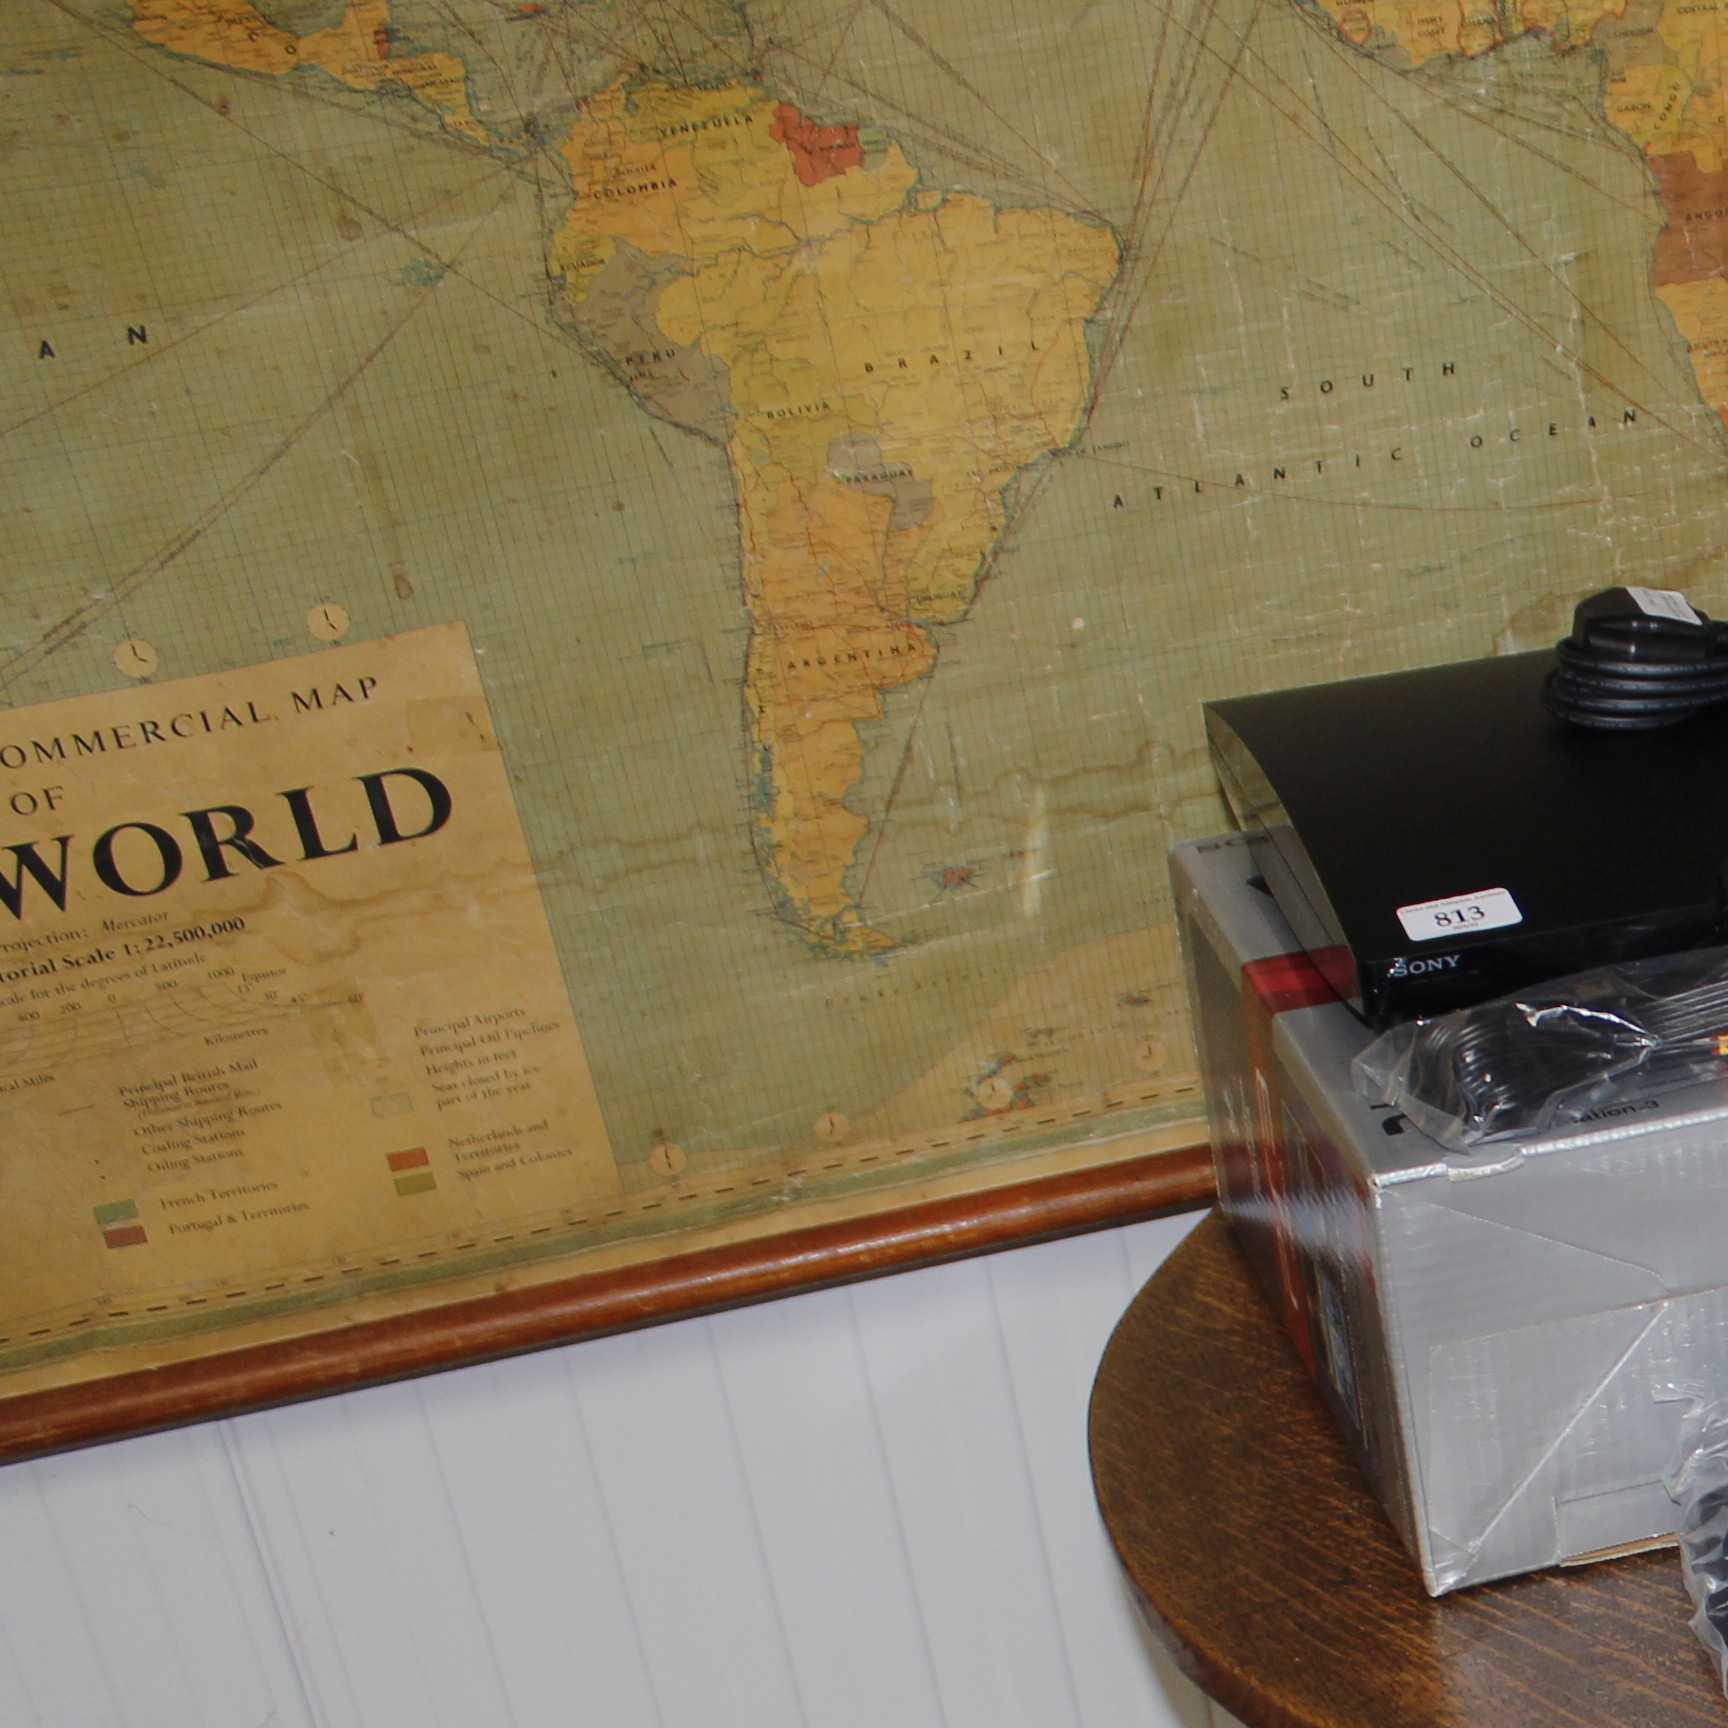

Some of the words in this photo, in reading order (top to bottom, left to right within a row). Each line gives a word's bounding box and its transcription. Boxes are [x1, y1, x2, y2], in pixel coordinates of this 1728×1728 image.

[659, 115, 754, 138] VENEZUELA
[592, 178, 678, 200] COLOMBIA
[625, 350, 677, 365] PERU
[864, 340, 1039, 373] BRAZIL
[1280, 362, 1456, 400] SOUTH
[766, 401, 831, 419] BOLIVIA
[1112, 447, 1403, 510] ATLANTIC
[1469, 408, 1638, 449] OCEAN
[787, 642, 916, 670] ARGENTINA
[0, 701, 272, 769] OMMERCIAL
[291, 676, 379, 714] MAP
[10, 785, 65, 816] OF
[0, 767, 453, 921] WORLD
[1434, 905, 1485, 927] 813
[62, 947, 116, 970] Scale
[1394, 954, 1461, 978] SONY
